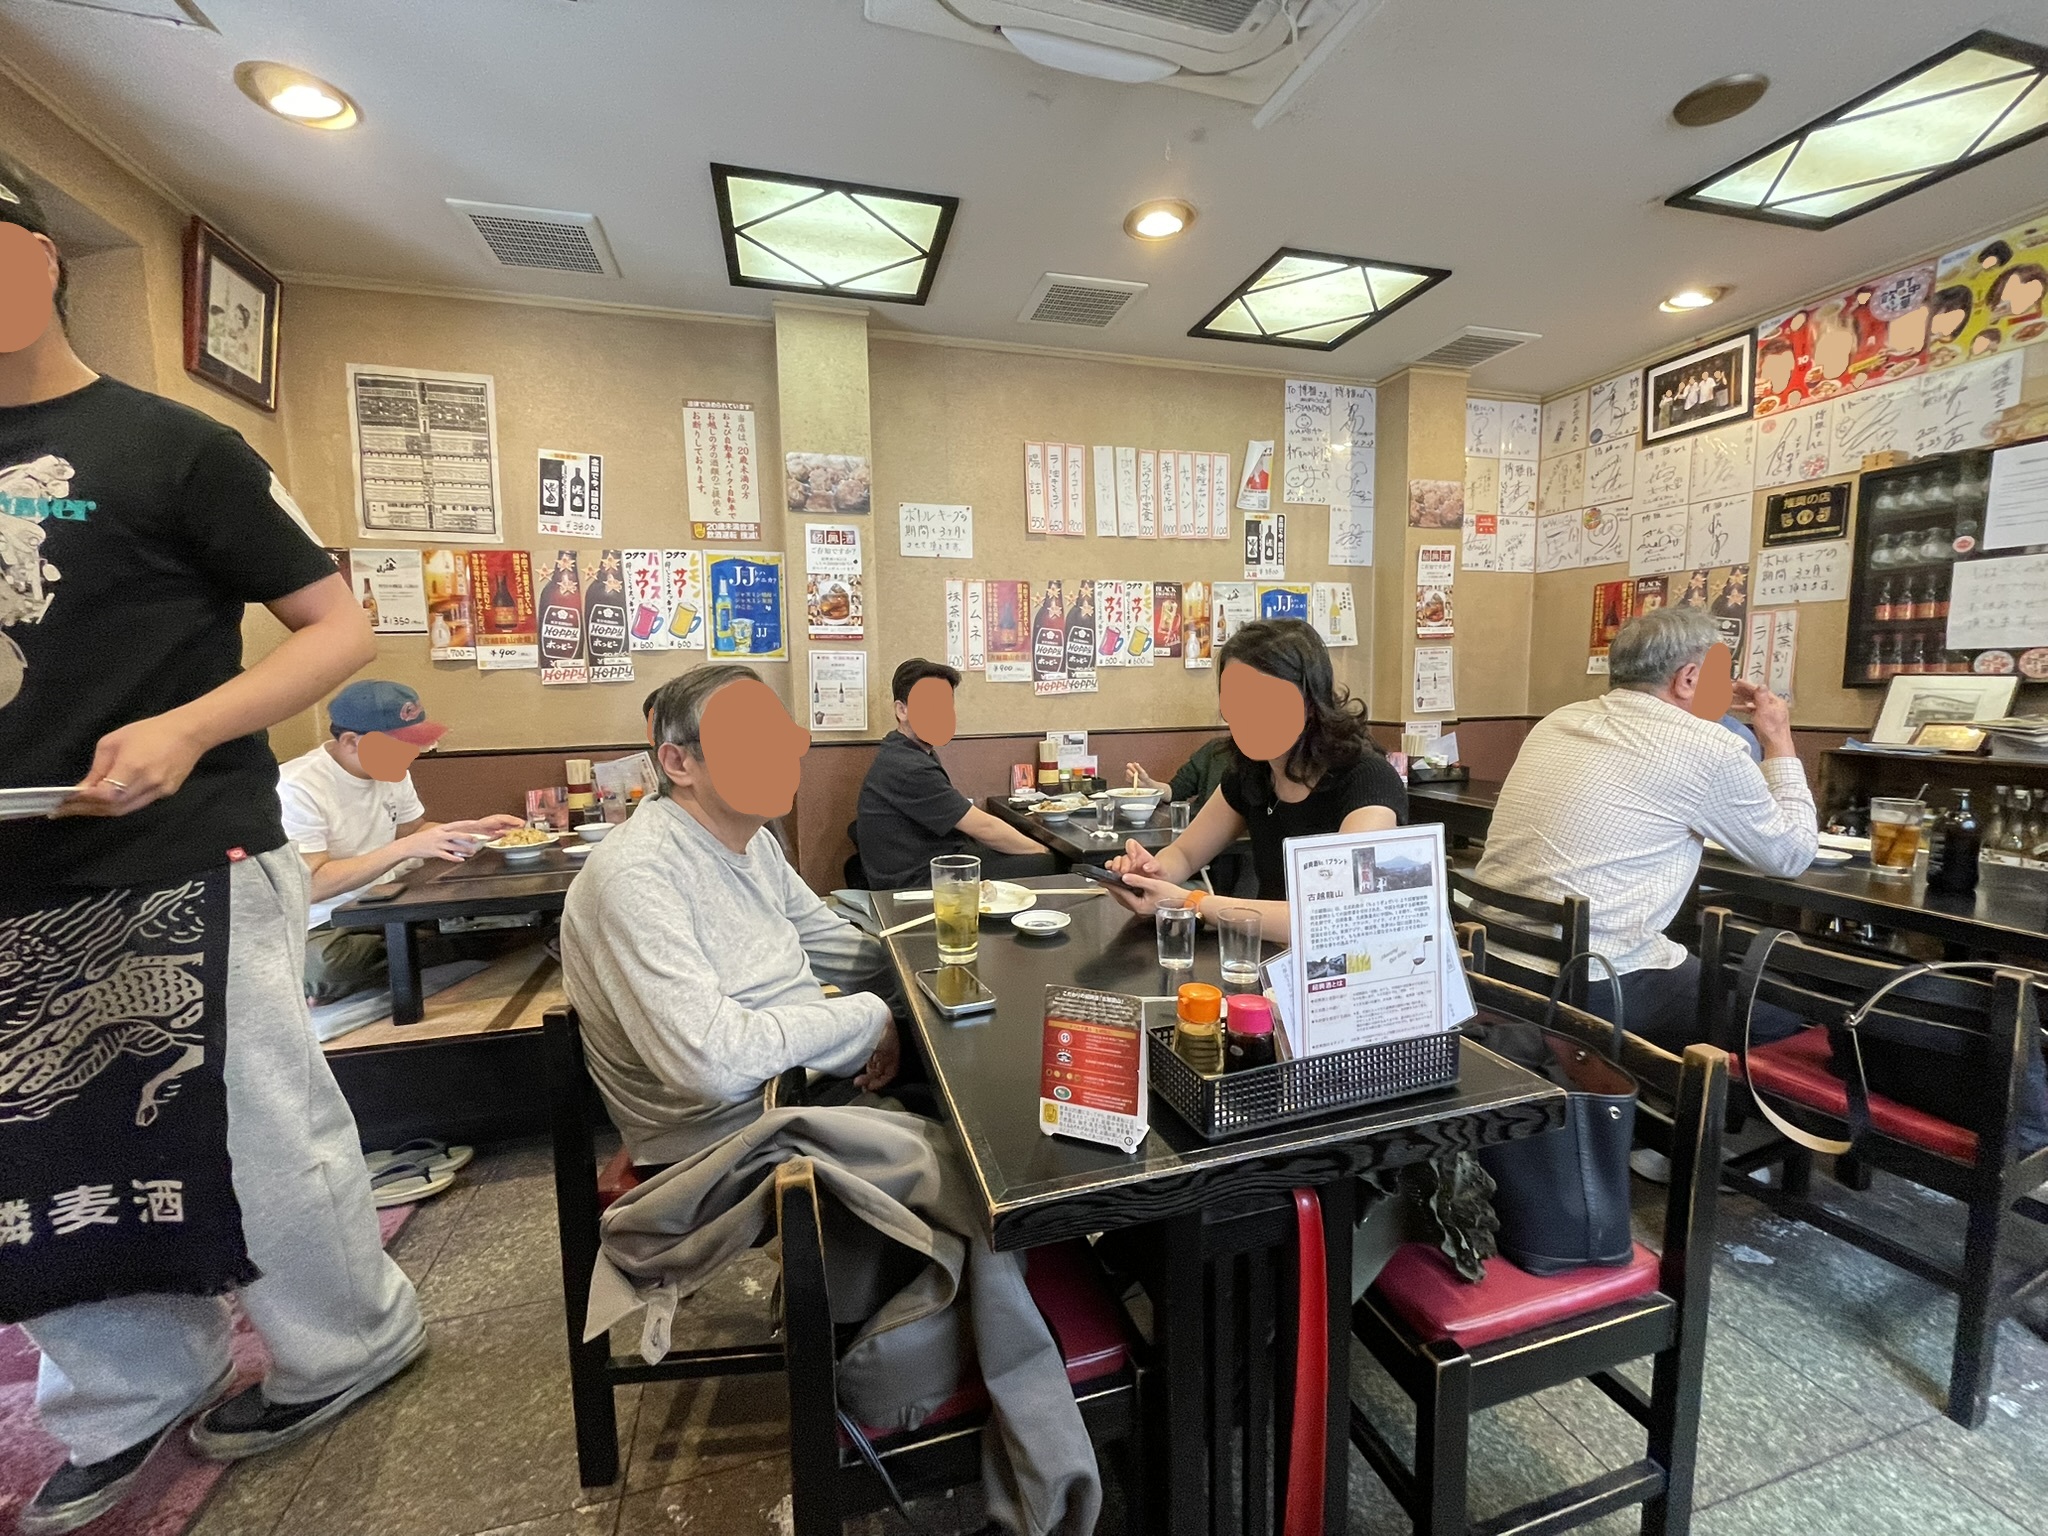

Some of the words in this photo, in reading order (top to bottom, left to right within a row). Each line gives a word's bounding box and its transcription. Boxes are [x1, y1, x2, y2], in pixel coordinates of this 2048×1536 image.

[692, 412, 707, 495] お断りしております。
[723, 412, 736, 520] および自動車・バイク・自転車で
[737, 414, 750, 500] 当店は、20歳未満の方
[1032, 517, 1045, 529] 550
[666, 551, 687, 559] コダマ
[635, 568, 650, 599] サワー
[648, 552, 661, 599] バイス
[673, 568, 688, 598] サワー
[689, 553, 700, 598] レモン
[729, 566, 756, 586] JJ
[969, 592, 982, 641] ラムネ
[1273, 595, 1292, 612] JJ
[756, 628, 767, 638] JJ
[970, 654, 984, 666] 350
[1750, 625, 1767, 678] ラムネ
